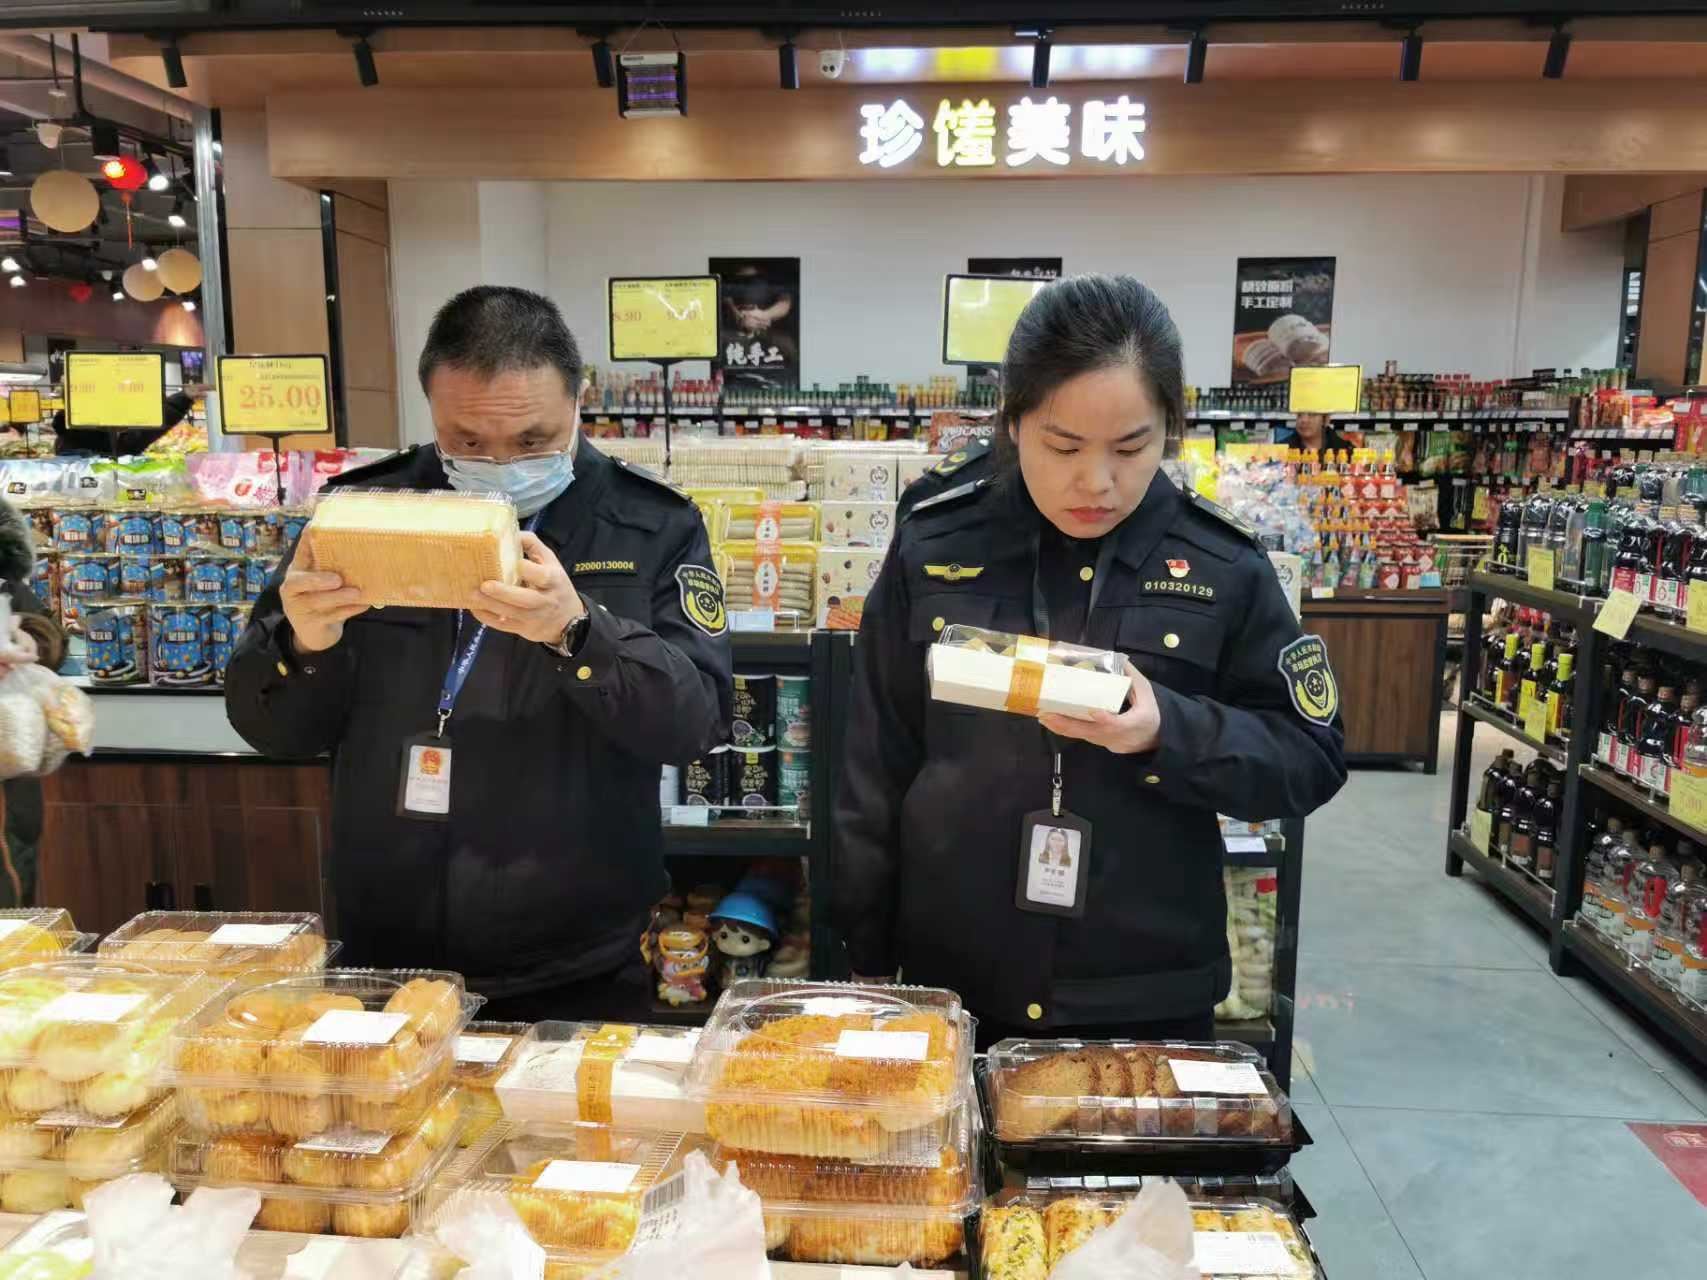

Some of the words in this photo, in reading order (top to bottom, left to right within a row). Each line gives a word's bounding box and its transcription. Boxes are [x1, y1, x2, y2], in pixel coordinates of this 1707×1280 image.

[858, 95, 1147, 169] 珍馐美味
[726, 341, 784, 366] 纯手工
[239, 384, 321, 409] 25.00
[1144, 581, 1214, 597] 010320129
